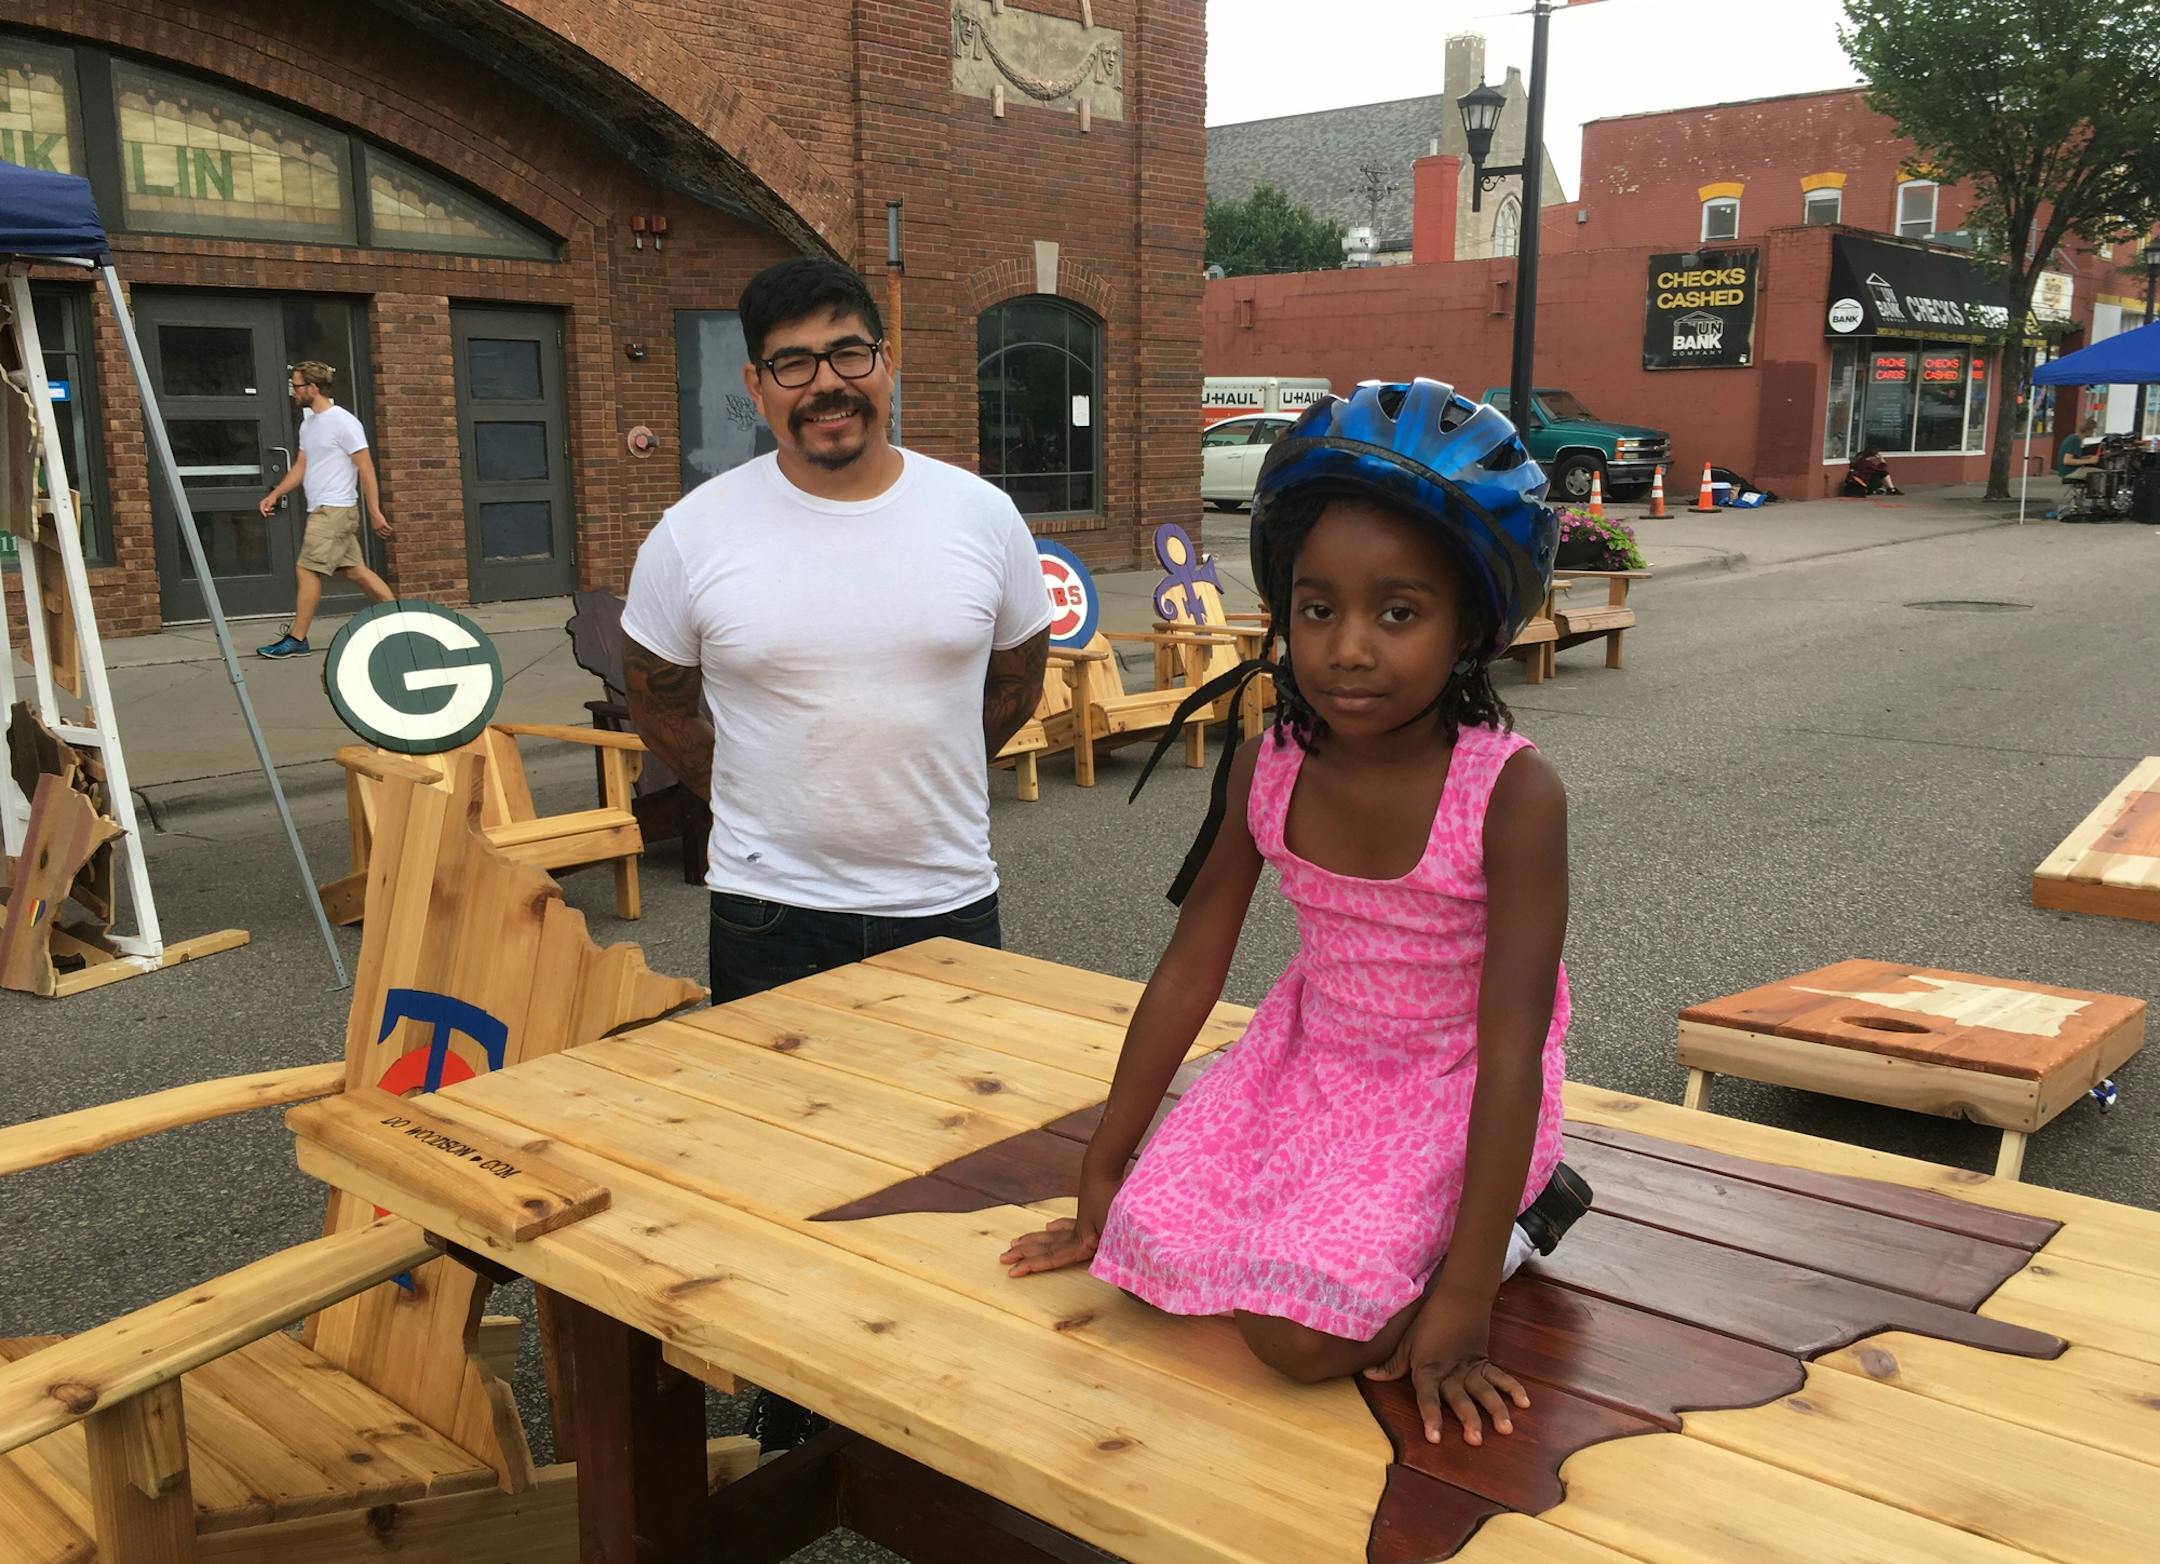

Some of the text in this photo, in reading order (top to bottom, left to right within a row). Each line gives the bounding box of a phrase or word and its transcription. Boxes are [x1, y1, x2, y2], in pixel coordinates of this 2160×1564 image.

[1657, 268, 1746, 290] CHECKS
[1656, 289, 1744, 309] CASHED
[1906, 296, 1966, 326] CHECKS
[1832, 314, 1859, 324] BANK
[1698, 322, 1722, 335] UN
[1672, 334, 1722, 350] BANK
[1876, 358, 1906, 367] PHONE
[1924, 358, 1960, 369] CHECKS
[1875, 370, 1906, 380] CARDS
[1923, 370, 1958, 380] CASHED
[336, 611, 493, 740] G
[380, 1117, 522, 1179] DO WOODSON COM
